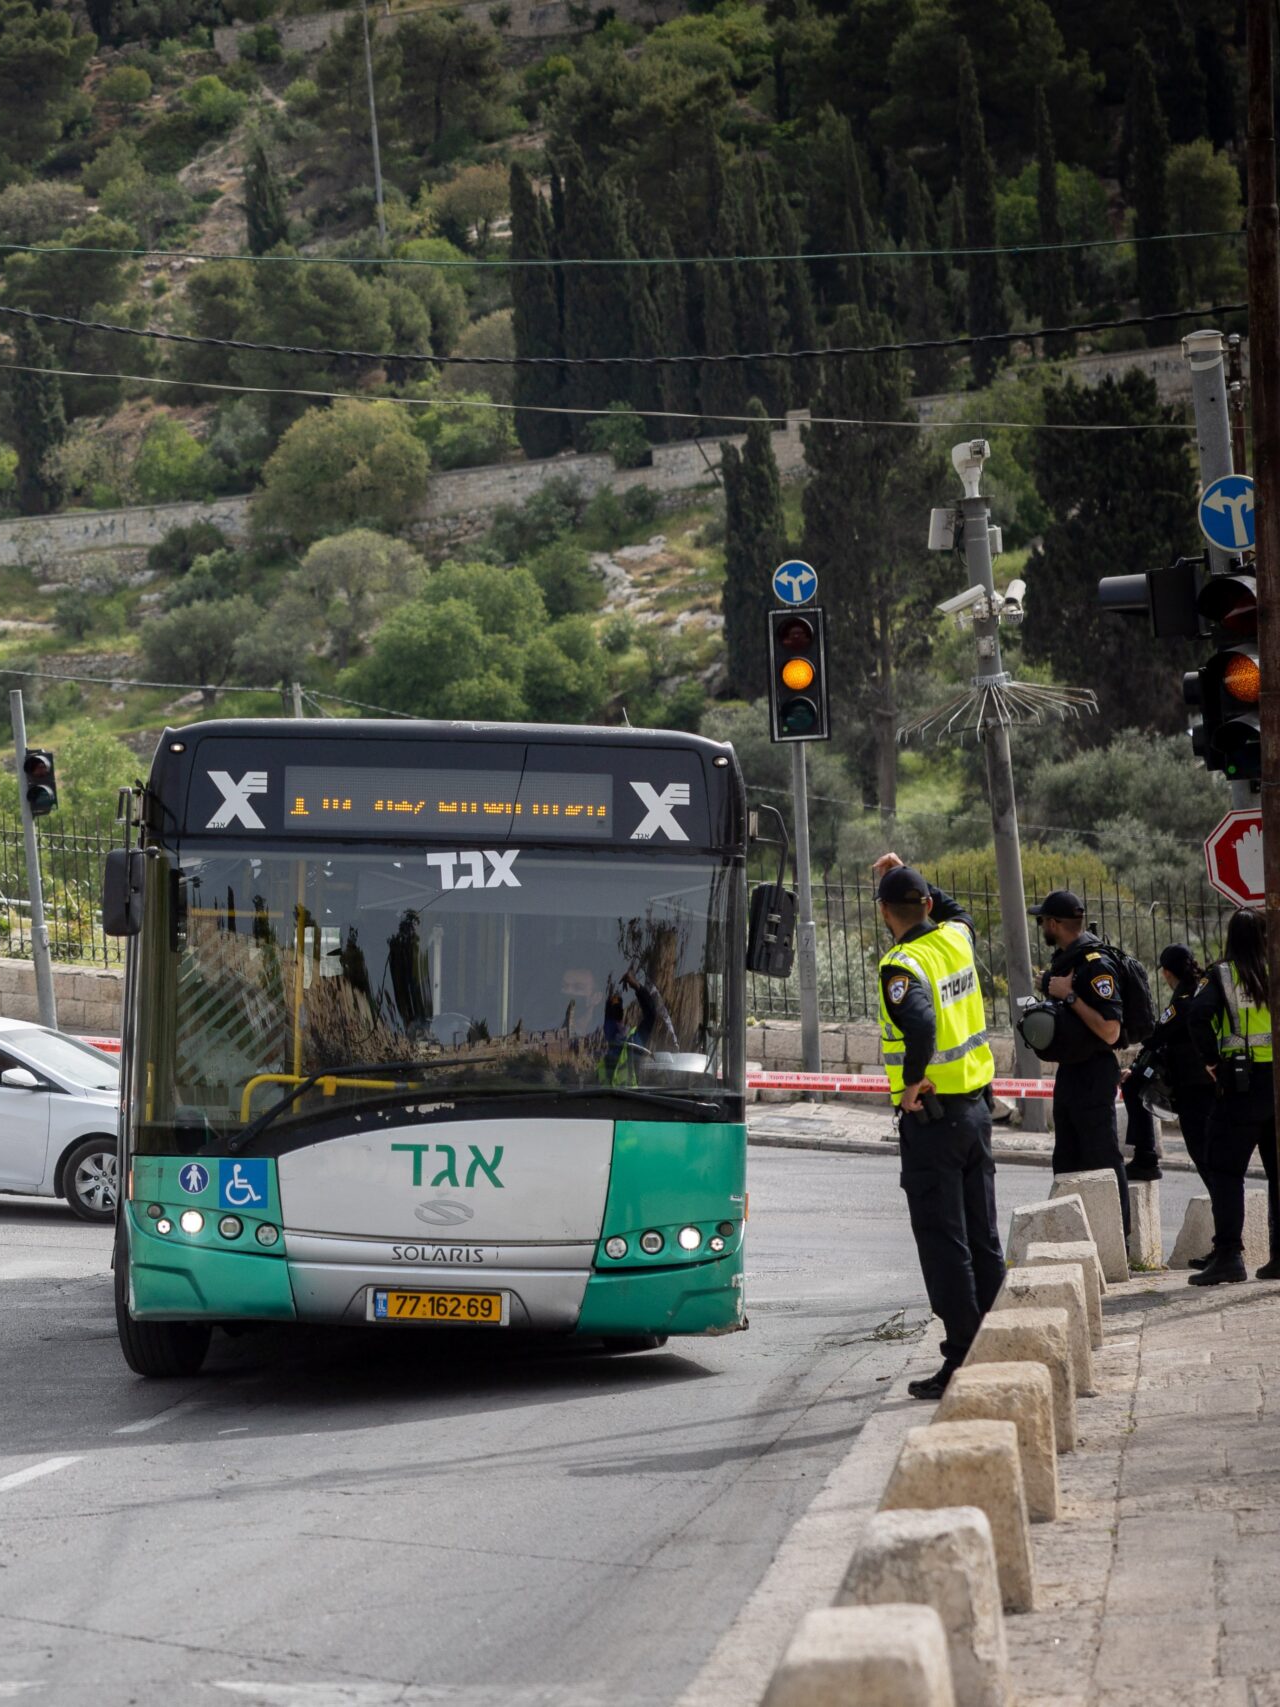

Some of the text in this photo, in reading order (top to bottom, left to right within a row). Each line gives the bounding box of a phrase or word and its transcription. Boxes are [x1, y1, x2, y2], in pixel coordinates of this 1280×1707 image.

[426, 849, 522, 890] אגד
[941, 971, 973, 1002] משטרה
[391, 1144, 505, 1188] אגד
[392, 1245, 484, 1263] SOLARIS
